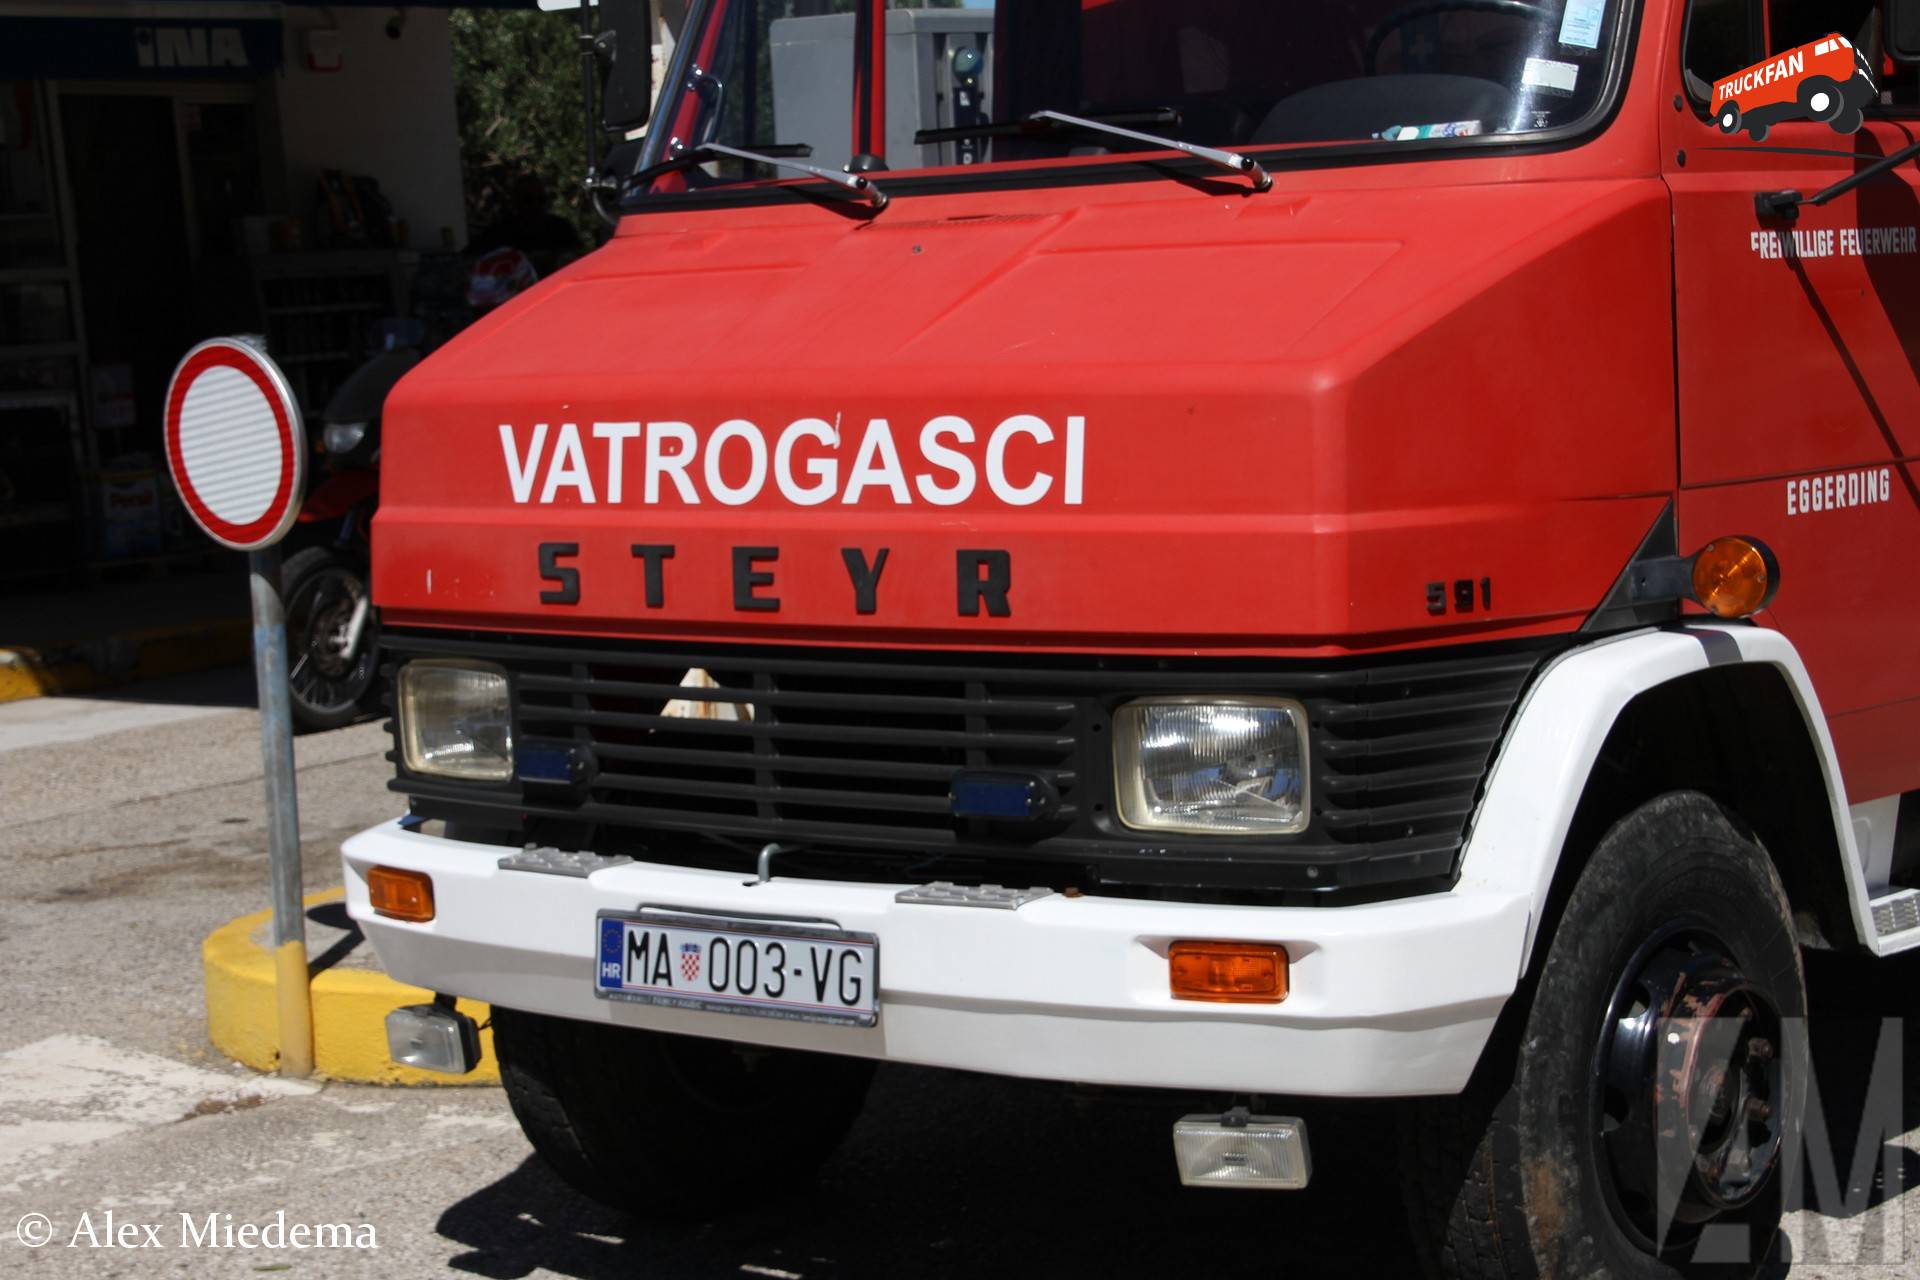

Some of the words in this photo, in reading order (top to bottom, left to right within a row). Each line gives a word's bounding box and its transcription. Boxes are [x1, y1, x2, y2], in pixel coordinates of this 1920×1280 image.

[1750, 229, 1834, 259] FREIWILLIGE
[1840, 226, 1917, 256] FEUERWEHR
[498, 414, 1086, 505] VATROGASCI
[1787, 469, 1891, 515] EGGERDING
[538, 542, 1012, 617] STEYR
[1425, 576, 1492, 615] 591
[602, 962, 621, 979] HR
[626, 929, 673, 987] MA
[708, 936, 864, 1006] 003-VG
